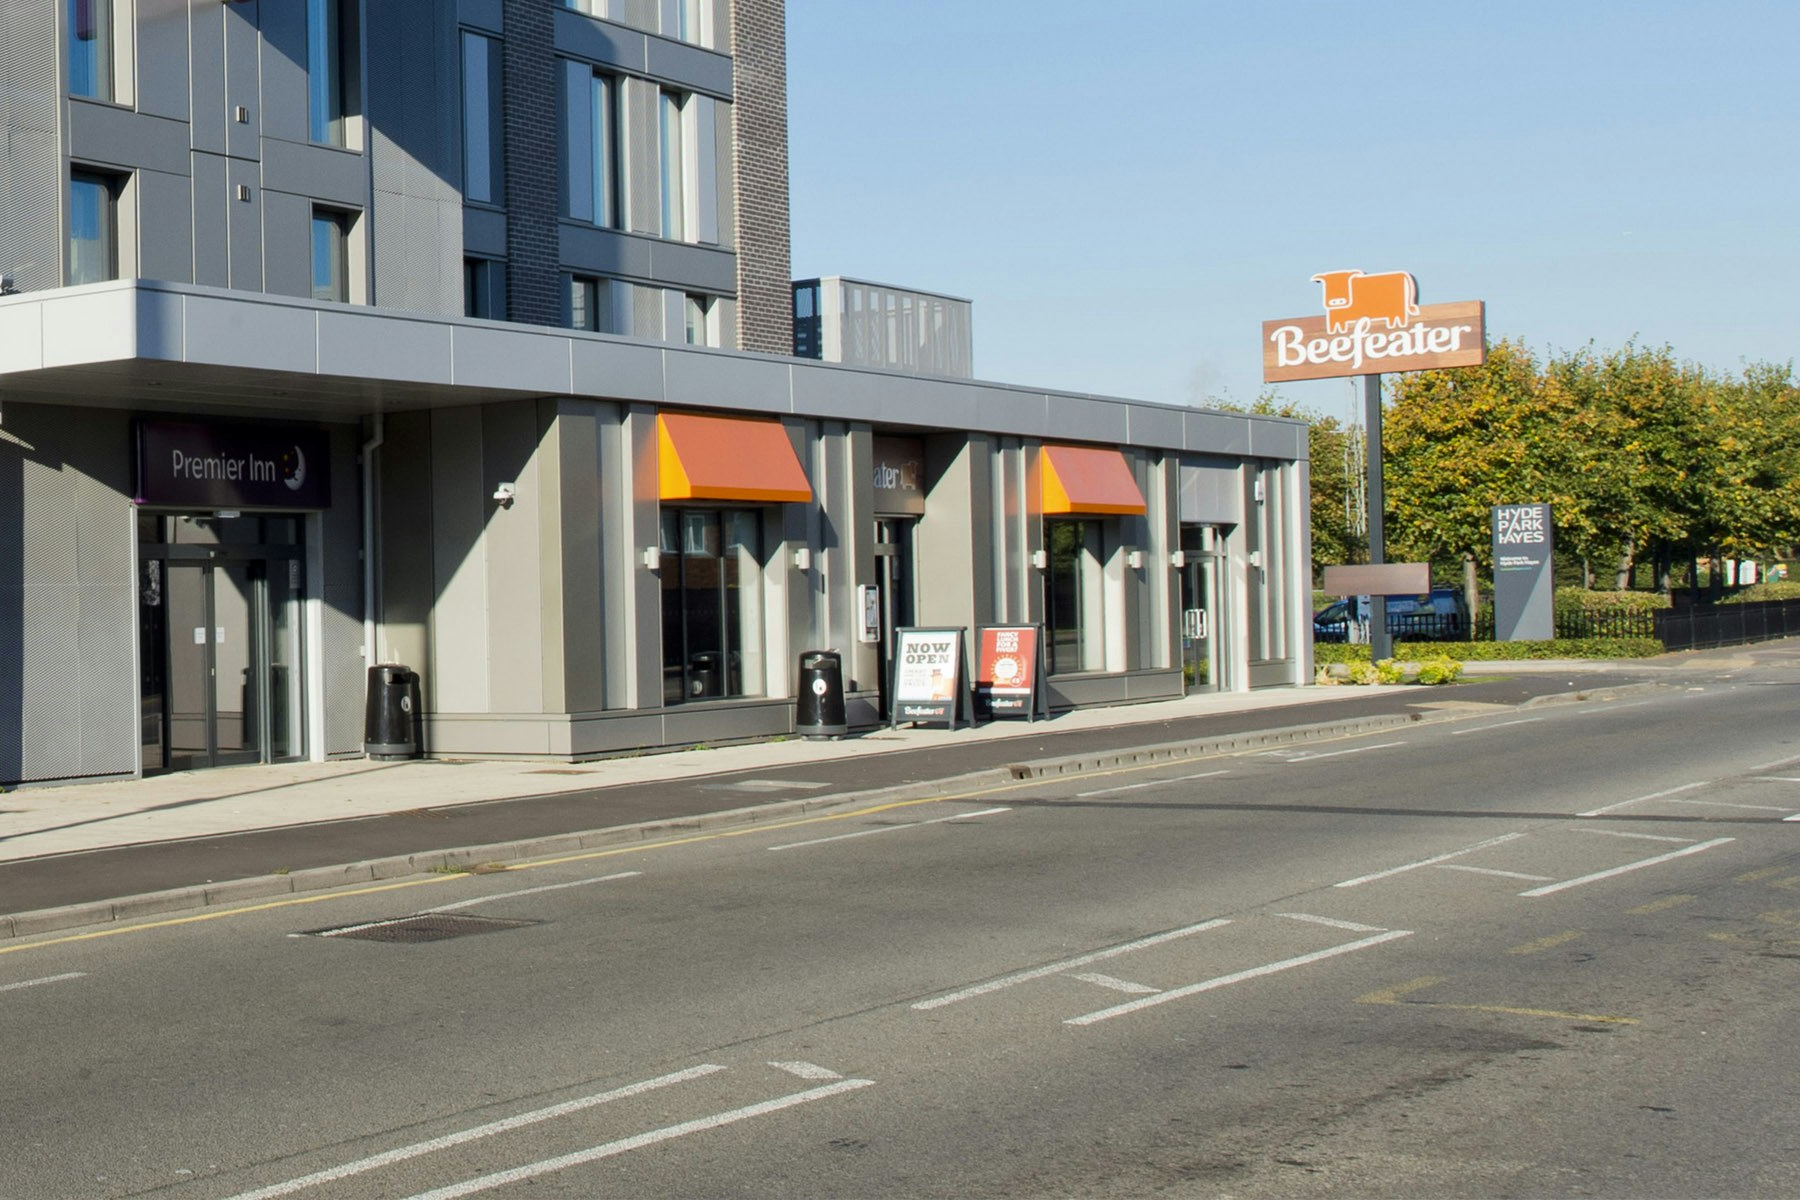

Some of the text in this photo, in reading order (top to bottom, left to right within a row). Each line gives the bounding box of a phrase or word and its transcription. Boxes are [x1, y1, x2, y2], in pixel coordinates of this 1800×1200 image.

[1270, 316, 1472, 369] Beefeater
[172, 449, 276, 482] Premier Inn
[1497, 506, 1543, 520] HYDE
[1498, 519, 1544, 532] PARK
[1498, 531, 1545, 544] HAYES
[906, 642, 951, 654] NOW
[905, 654, 950, 664] OPEN
